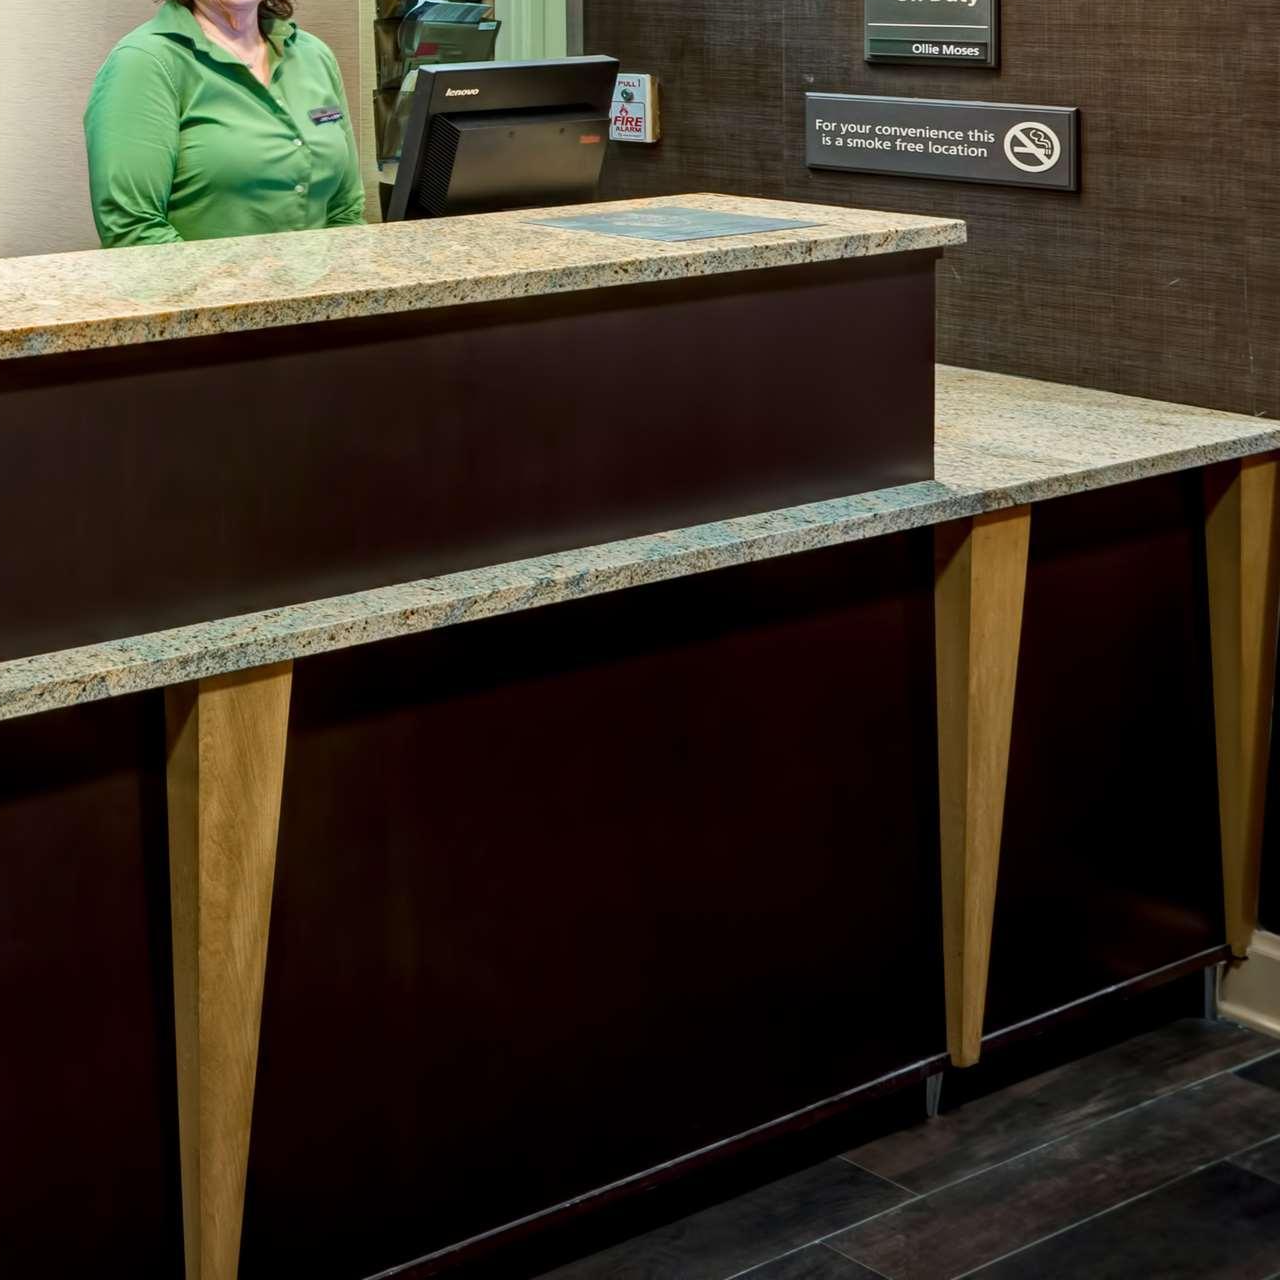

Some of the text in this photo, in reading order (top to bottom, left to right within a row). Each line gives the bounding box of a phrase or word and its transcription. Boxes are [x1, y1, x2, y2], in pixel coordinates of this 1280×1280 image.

[912, 43, 980, 56] Ollie Moses
[618, 80, 637, 88] PULL
[445, 87, 480, 97] lenovo
[613, 115, 643, 127] FIRE
[815, 119, 996, 143] For your convenience this
[821, 133, 988, 158] is a smoke free location
